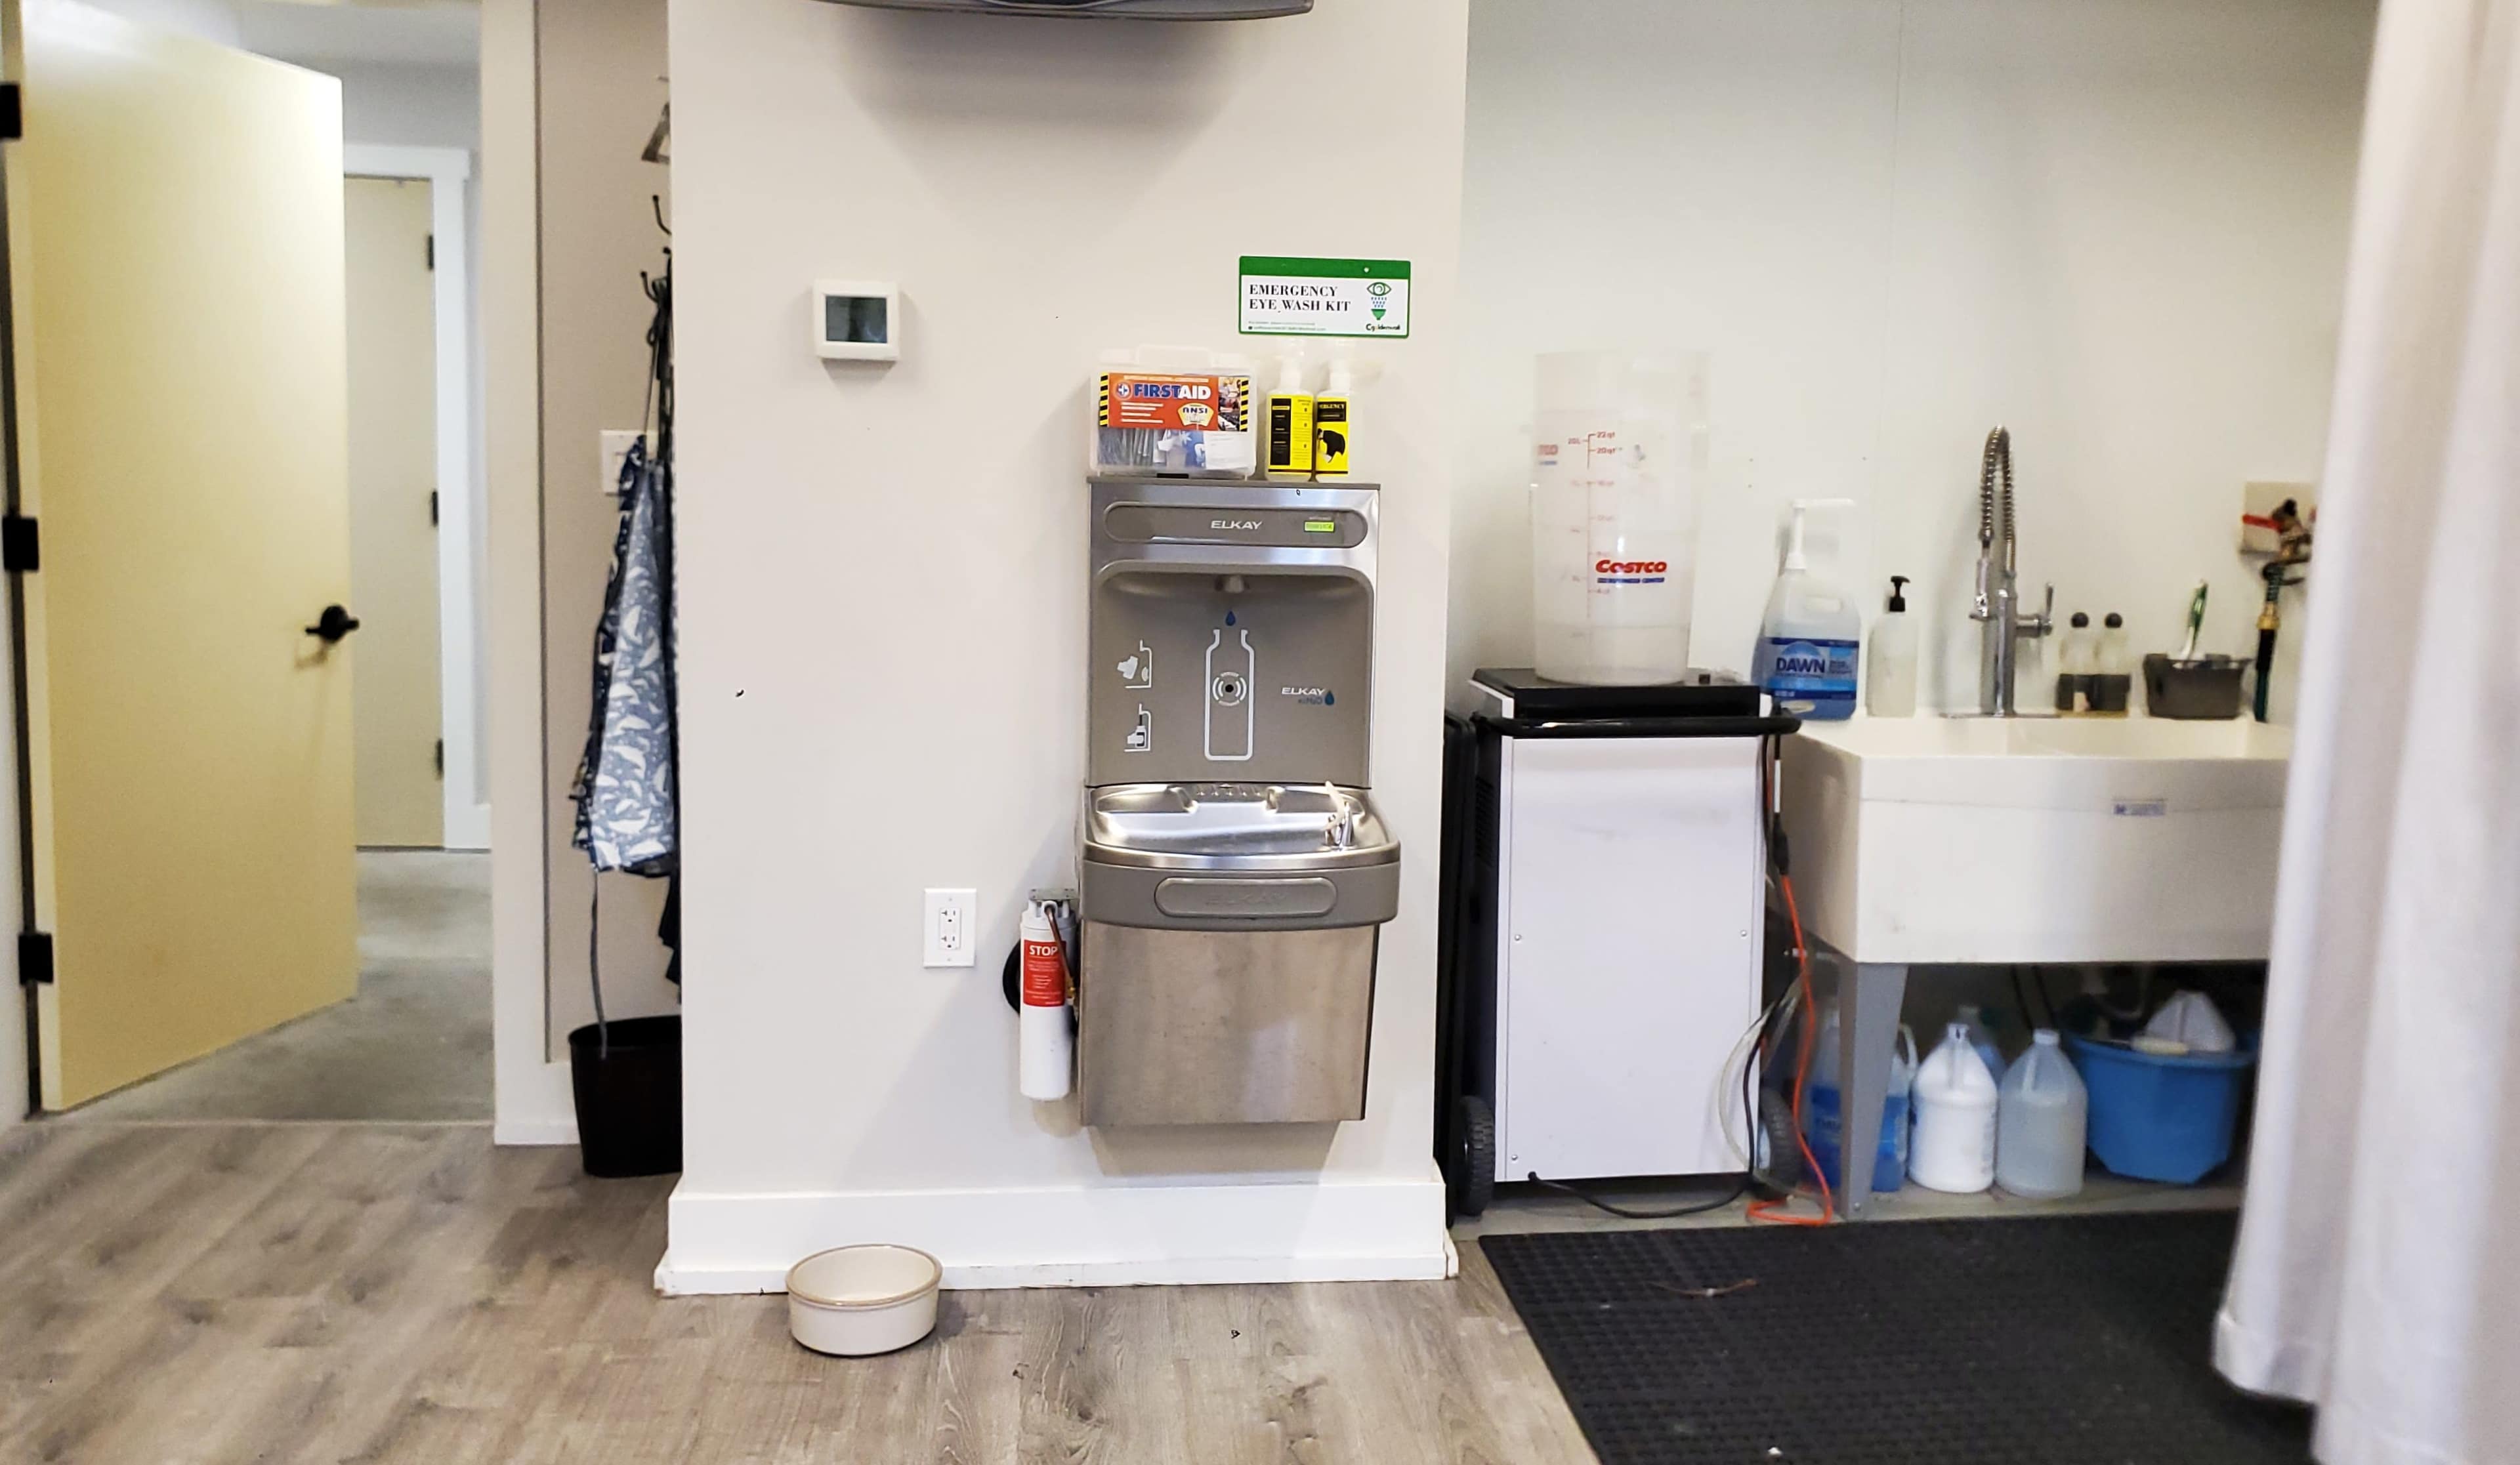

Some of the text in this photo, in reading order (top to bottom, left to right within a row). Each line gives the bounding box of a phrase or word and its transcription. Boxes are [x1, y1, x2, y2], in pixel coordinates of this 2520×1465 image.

[1249, 284, 1337, 297] EMERGENCY
[1250, 299, 1351, 312] EYE WASH KIT
[1211, 520, 1263, 530] ELKAY
[1776, 657, 1826, 673] DAWN
[1282, 687, 1325, 695] ELKAY
[1029, 945, 1058, 956] STOP
